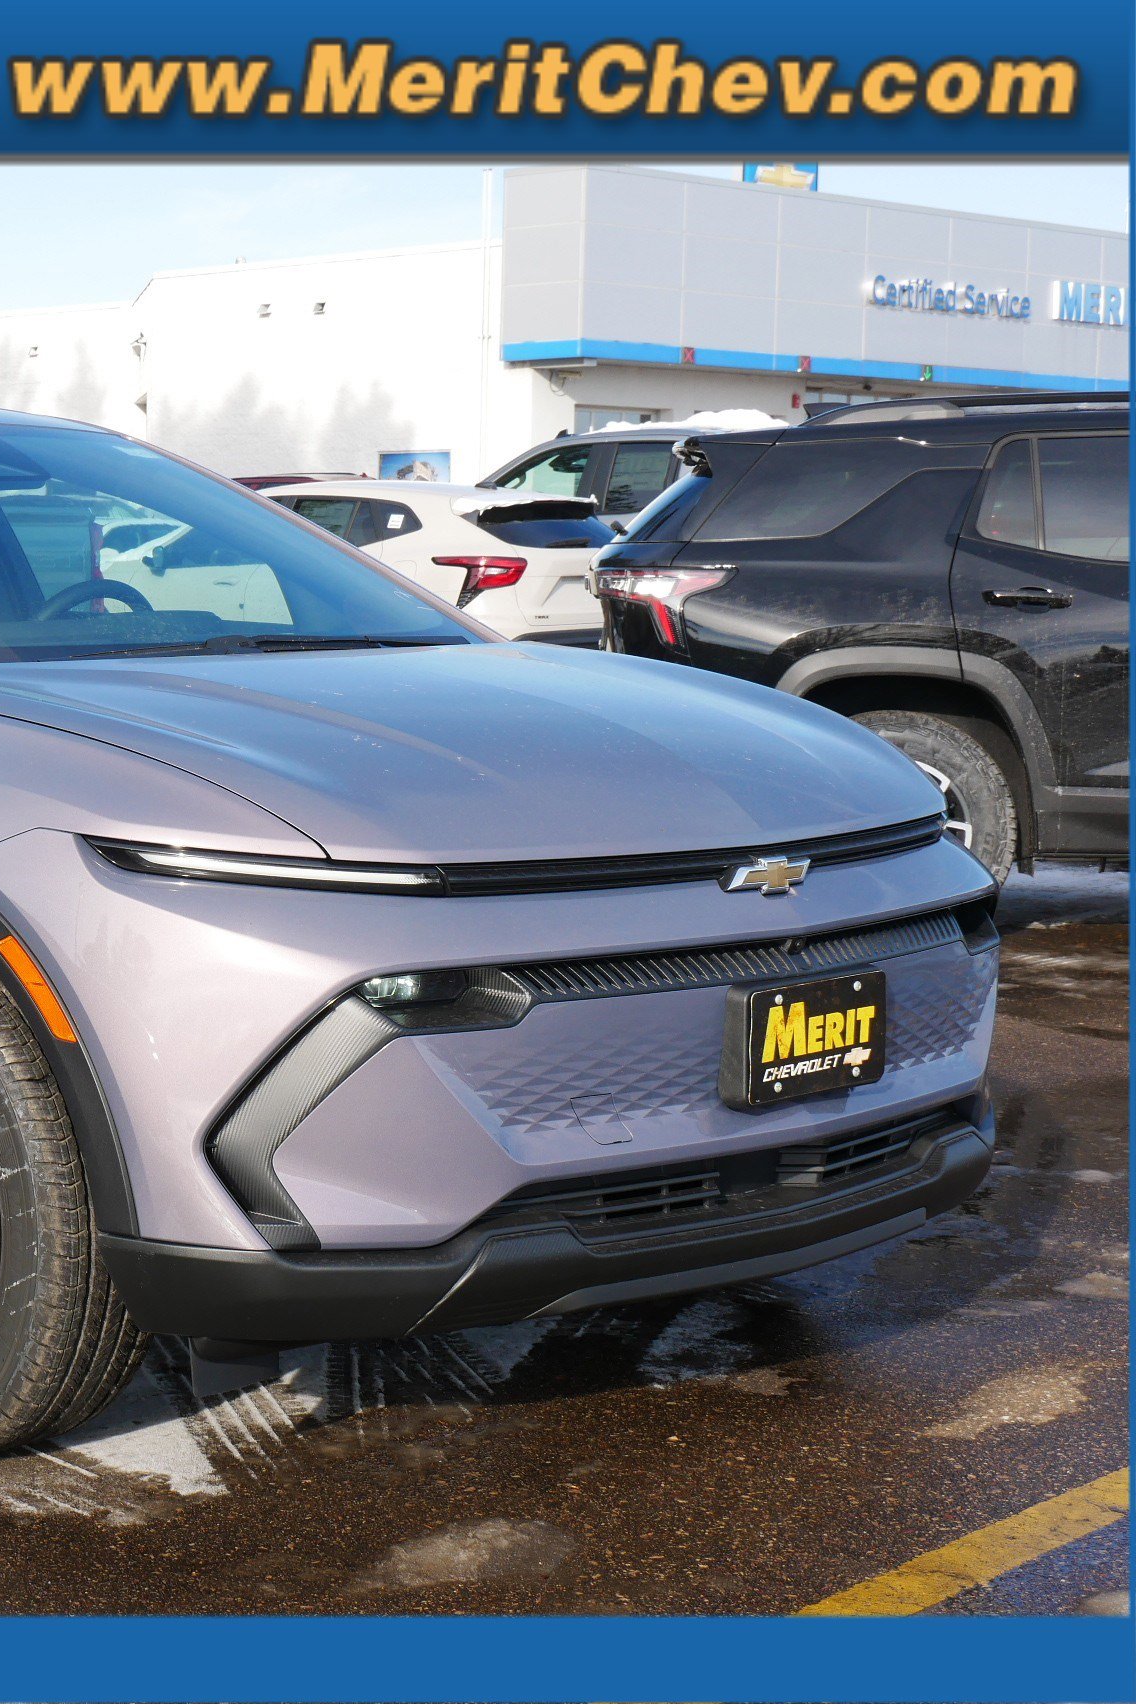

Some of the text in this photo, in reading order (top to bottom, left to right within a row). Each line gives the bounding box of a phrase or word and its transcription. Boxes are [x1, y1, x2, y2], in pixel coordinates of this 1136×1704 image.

[871, 273, 1032, 320] Certified Service
[762, 1053, 842, 1083] CHEVROLET
